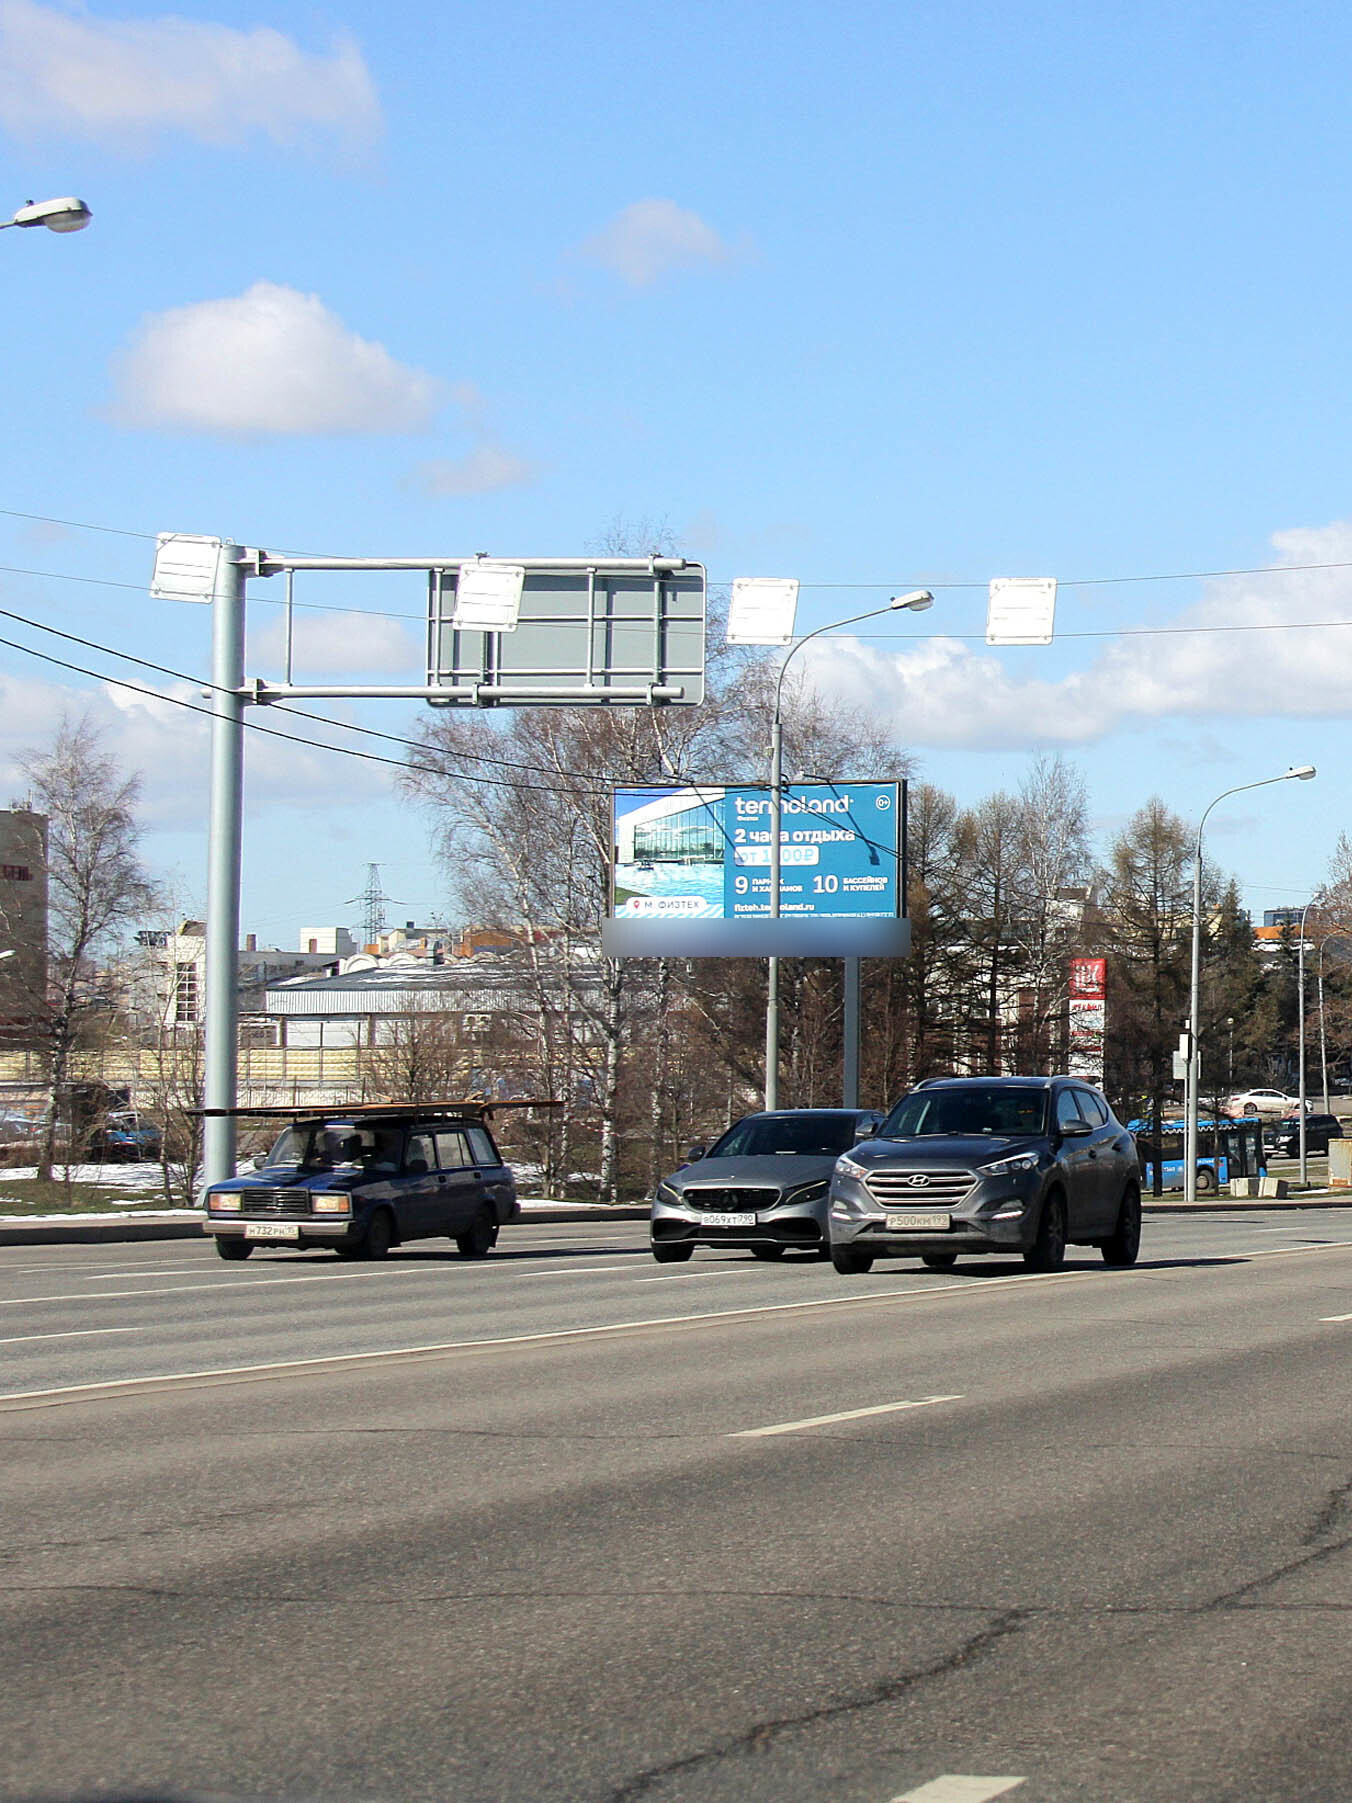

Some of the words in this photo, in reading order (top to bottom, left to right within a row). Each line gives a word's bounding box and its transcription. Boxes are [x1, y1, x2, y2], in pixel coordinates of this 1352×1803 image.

[735, 829, 746, 842] 2
[792, 829, 855, 844] отдыха
[735, 876, 748, 895] 9
[813, 875, 838, 894] 10
[843, 876, 888, 885] БАССЕЙНОВ
[851, 883, 885, 892] КУПЕЛЕЙ
[658, 901, 699, 909] ФИЗТЕХ
